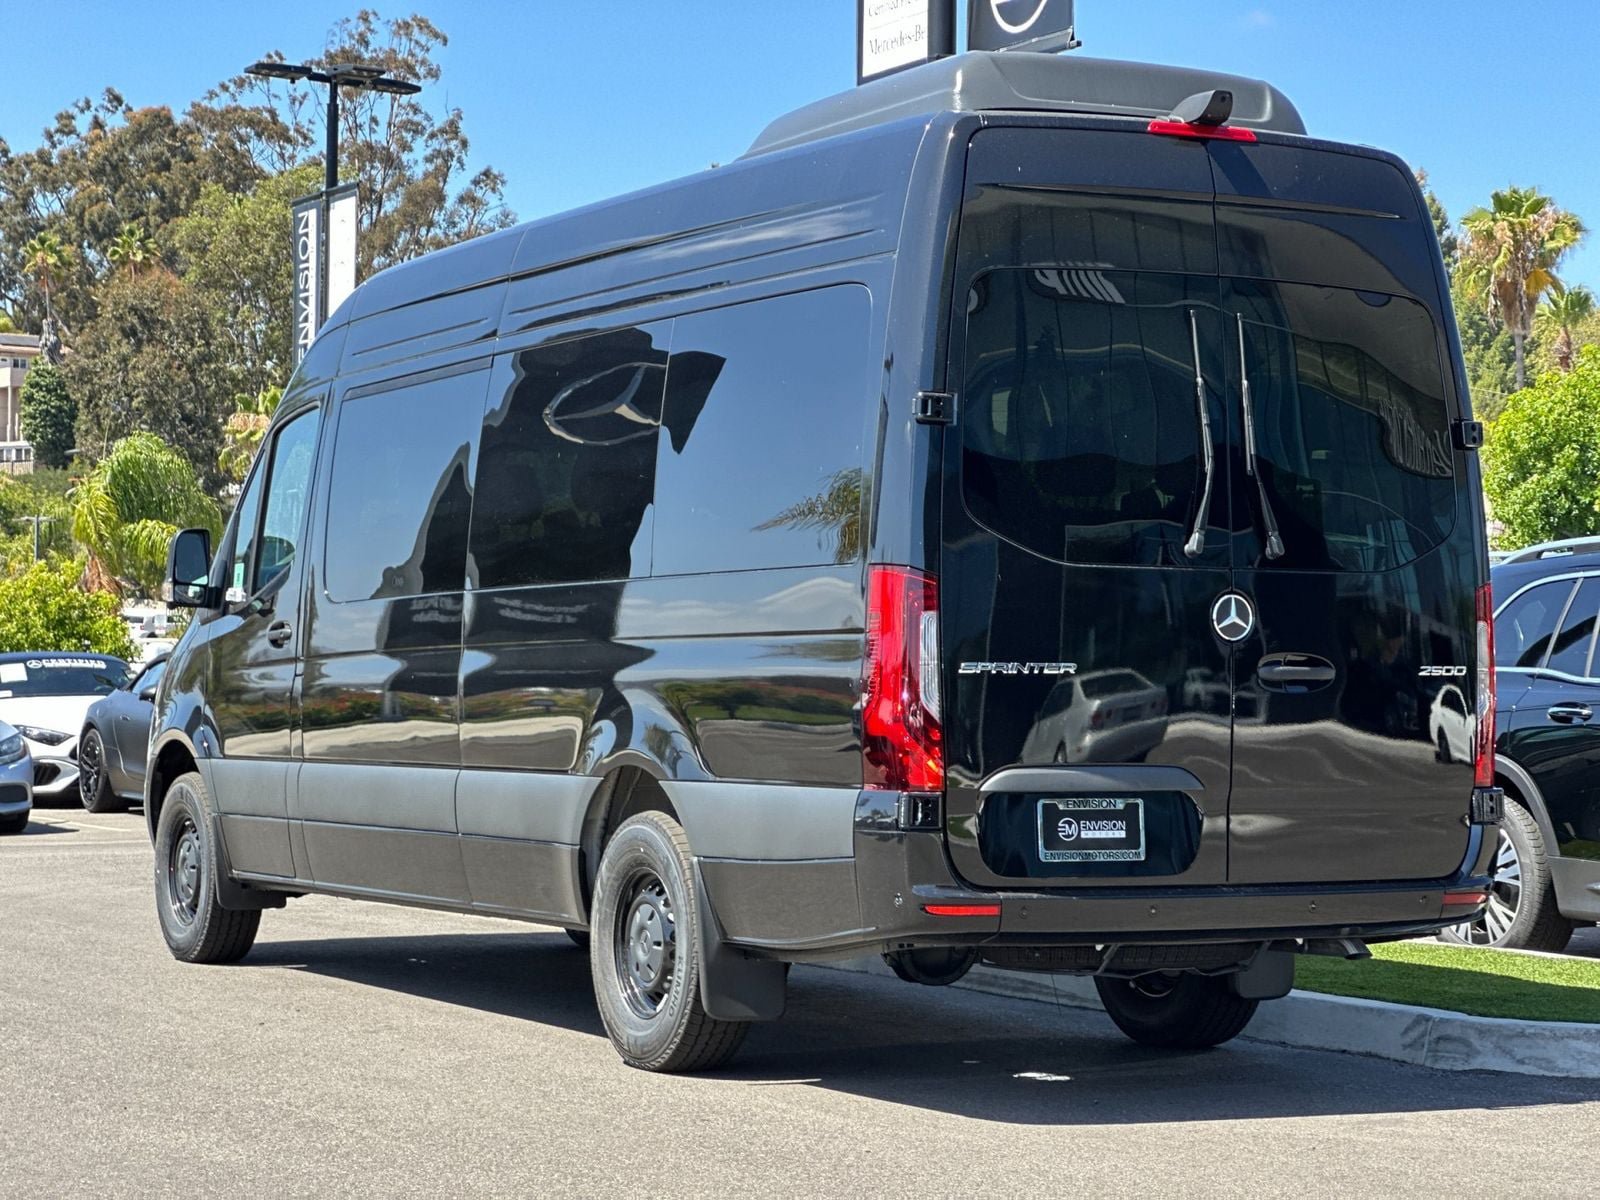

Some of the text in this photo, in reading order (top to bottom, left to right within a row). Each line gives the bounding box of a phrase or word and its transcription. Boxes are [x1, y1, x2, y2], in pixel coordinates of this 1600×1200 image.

[958, 662, 1078, 674] SPRINTER
[1418, 665, 1467, 676] 2500
[1066, 799, 1117, 809] ENVISION
[1080, 820, 1126, 830] ENVISION
[1044, 851, 1141, 861] ENVISIONMOTORS.COM
[668, 956, 684, 1018] KUMHO
